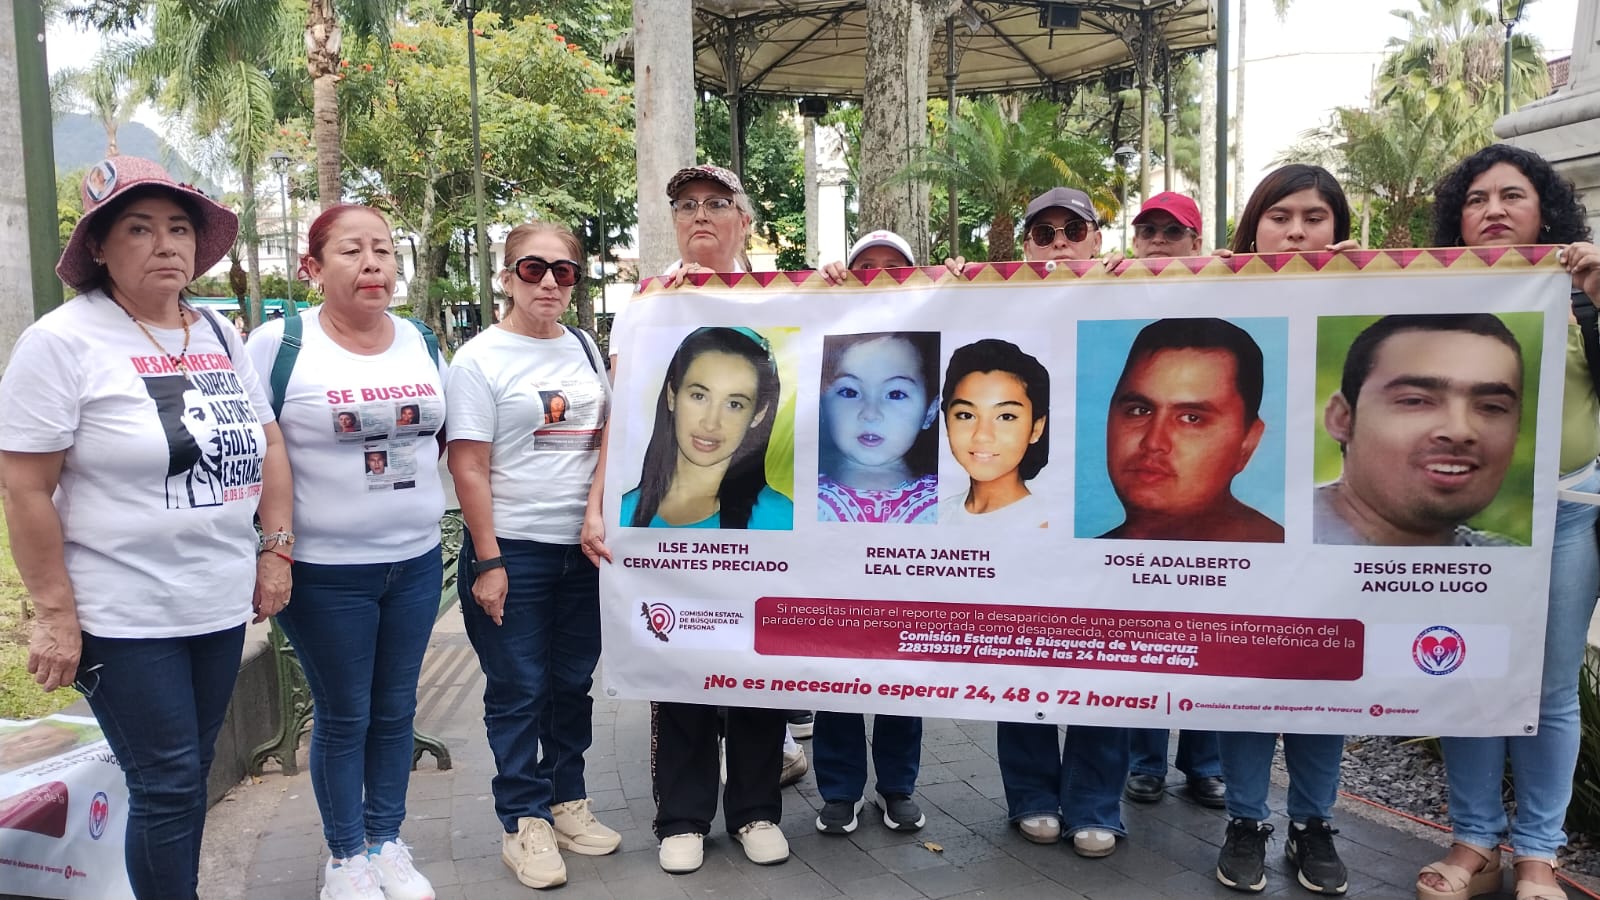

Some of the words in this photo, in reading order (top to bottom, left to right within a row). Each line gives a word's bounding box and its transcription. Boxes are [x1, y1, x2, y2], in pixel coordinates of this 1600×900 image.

[326, 389, 355, 405] SE
[360, 383, 437, 402] BUSCAN
[222, 424, 257, 457] SOLÍS
[658, 542, 688, 554] ILSE
[692, 543, 749, 555] JANETH
[866, 546, 926, 560] RENATA
[930, 548, 990, 561] JANETH
[623, 557, 708, 570] CERVANTES
[712, 559, 789, 572] PRECIADO
[1104, 553, 1145, 567] JOSÉ
[1149, 556, 1251, 570] ADALBERTO
[1353, 560, 1407, 575] JESÚS
[1412, 562, 1492, 575] ERNESTO
[864, 564, 902, 576] LEAL
[905, 565, 996, 579] CERVANTES
[1132, 573, 1172, 585] LEAL
[1177, 574, 1227, 587] URIBE
[1361, 581, 1434, 593] ANGULO
[1439, 581, 1488, 593] LUGO
[714, 611, 744, 619] ESTATAL
[777, 603, 787, 613] Si
[790, 604, 846, 616] necesitas
[849, 605, 885, 617] iniciar
[888, 607, 899, 617] el
[902, 609, 947, 620] reporte
[950, 610, 971, 621] por
[974, 609, 984, 621] la
[987, 611, 1067, 625] desaparición
[1070, 614, 1087, 625] de
[1090, 617, 1115, 627] una
[1118, 618, 1171, 629] persona
[1174, 620, 1183, 629] o
[1186, 619, 1227, 631] tienes
[1230, 620, 1314, 635] información
[1317, 625, 1339, 636] del
[762, 616, 816, 627] paradero
[818, 616, 834, 627] de
[837, 618, 860, 628] una
[863, 619, 912, 630] persona
[915, 620, 975, 632] reportada
[978, 623, 1014, 633] como
[1017, 624, 1105, 639] desaparecida,
[1189, 633, 1197, 642] a
[1200, 631, 1212, 642] la
[1215, 631, 1248, 644] línea
[1251, 634, 1319, 648] telefónica
[1322, 636, 1341, 648] de
[1344, 636, 1356, 648] la
[899, 630, 960, 642] Comisión
[963, 633, 1012, 645] Estatal
[1015, 634, 1032, 646] de
[1035, 636, 1105, 650] Búsqueda
[1108, 640, 1127, 651] de
[1130, 640, 1199, 654] Veracruz:
[897, 642, 972, 655] 2283193187
[973, 644, 1049, 659] (disponible
[1052, 648, 1073, 660] las
[1075, 650, 1094, 661] 24
[1096, 651, 1138, 663] horas
[1140, 653, 1164, 664] del
[1166, 654, 1199, 669] día).
[703, 674, 738, 690] ¡No
[742, 678, 766, 690] es
[770, 678, 873, 695] necesario
[877, 683, 959, 700] esperar
[964, 684, 996, 704] 24,
[1002, 687, 1031, 703] 48
[1035, 691, 1050, 704] o
[1056, 689, 1082, 706] 72
[1086, 690, 1159, 710] horas!
[1194, 702, 1231, 710] Comisión
[1231, 703, 1261, 711] Estatal
